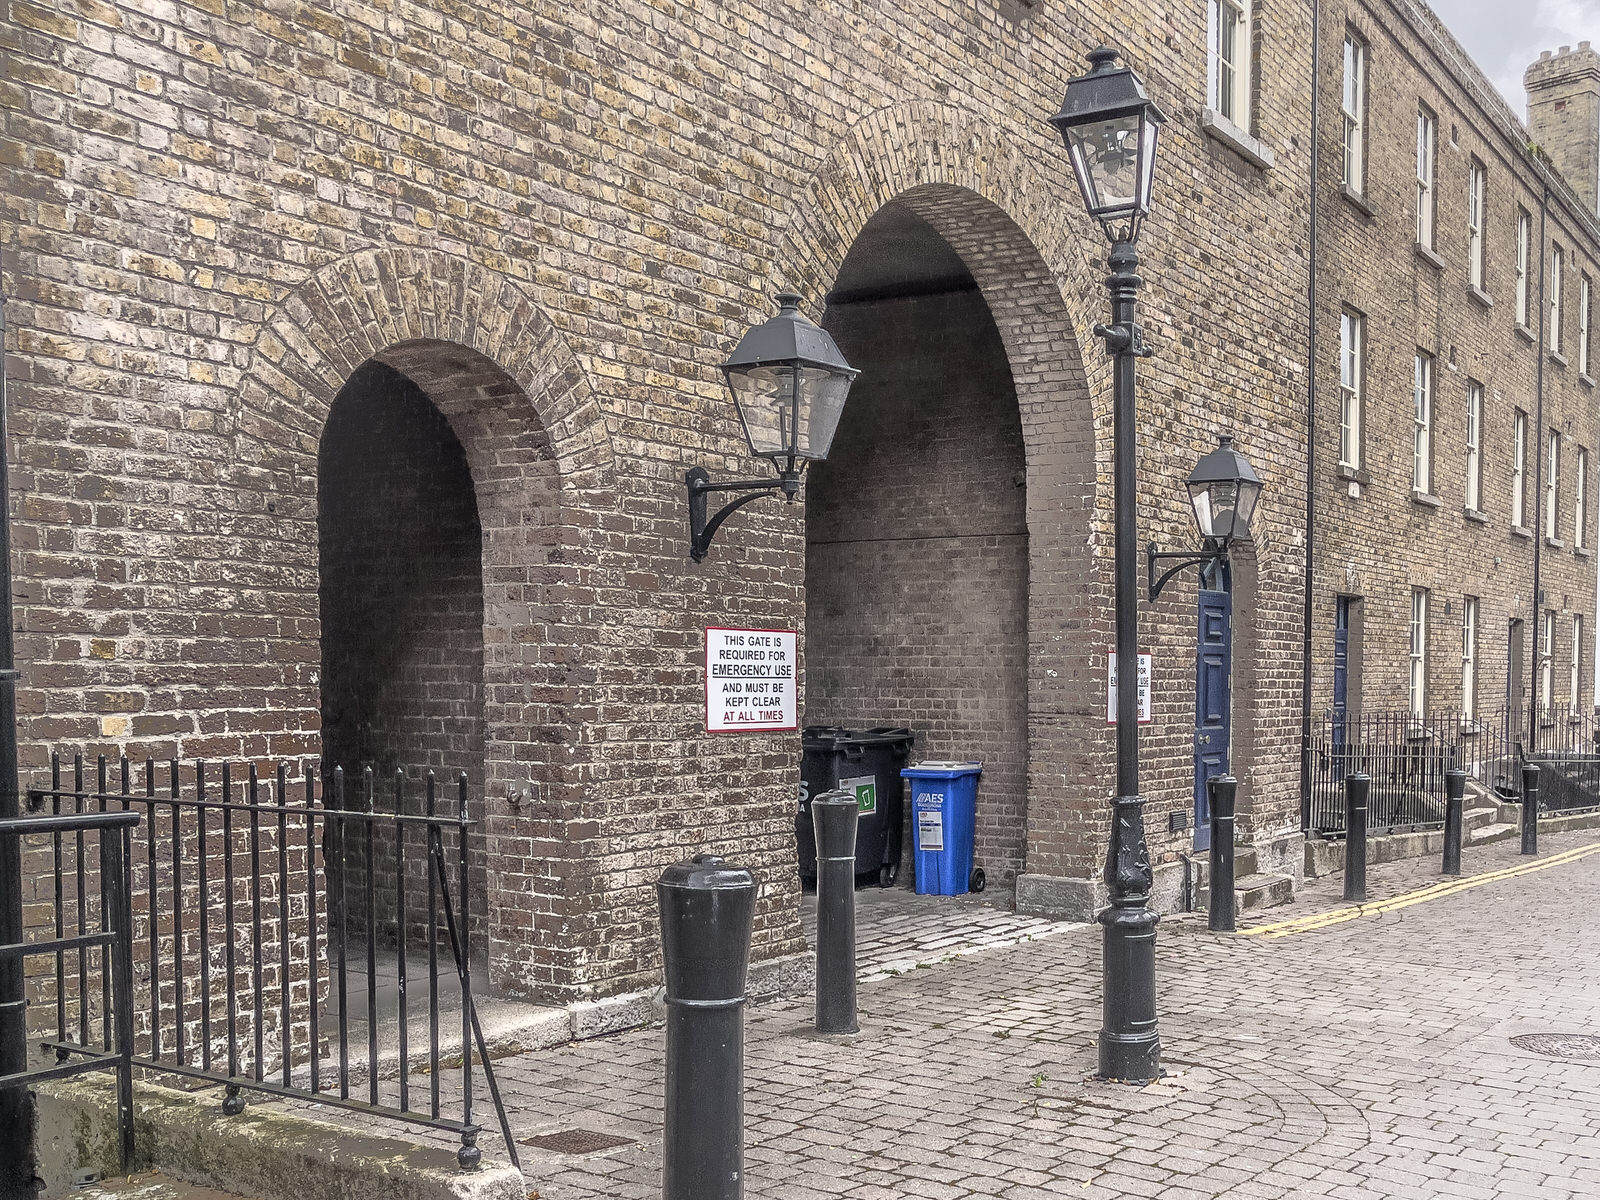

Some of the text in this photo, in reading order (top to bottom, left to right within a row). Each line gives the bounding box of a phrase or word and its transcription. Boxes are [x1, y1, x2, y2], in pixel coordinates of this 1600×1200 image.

[724, 635, 782, 647] THIS GATE IS
[719, 649, 786, 661] REQUIRED FOR
[712, 664, 792, 676] EMERGENCY USE
[722, 683, 784, 693] AND MUST BE
[725, 697, 781, 707] KEPT CLEAR
[723, 710, 784, 721] AT ALL TIMES
[924, 793, 944, 803] AES
